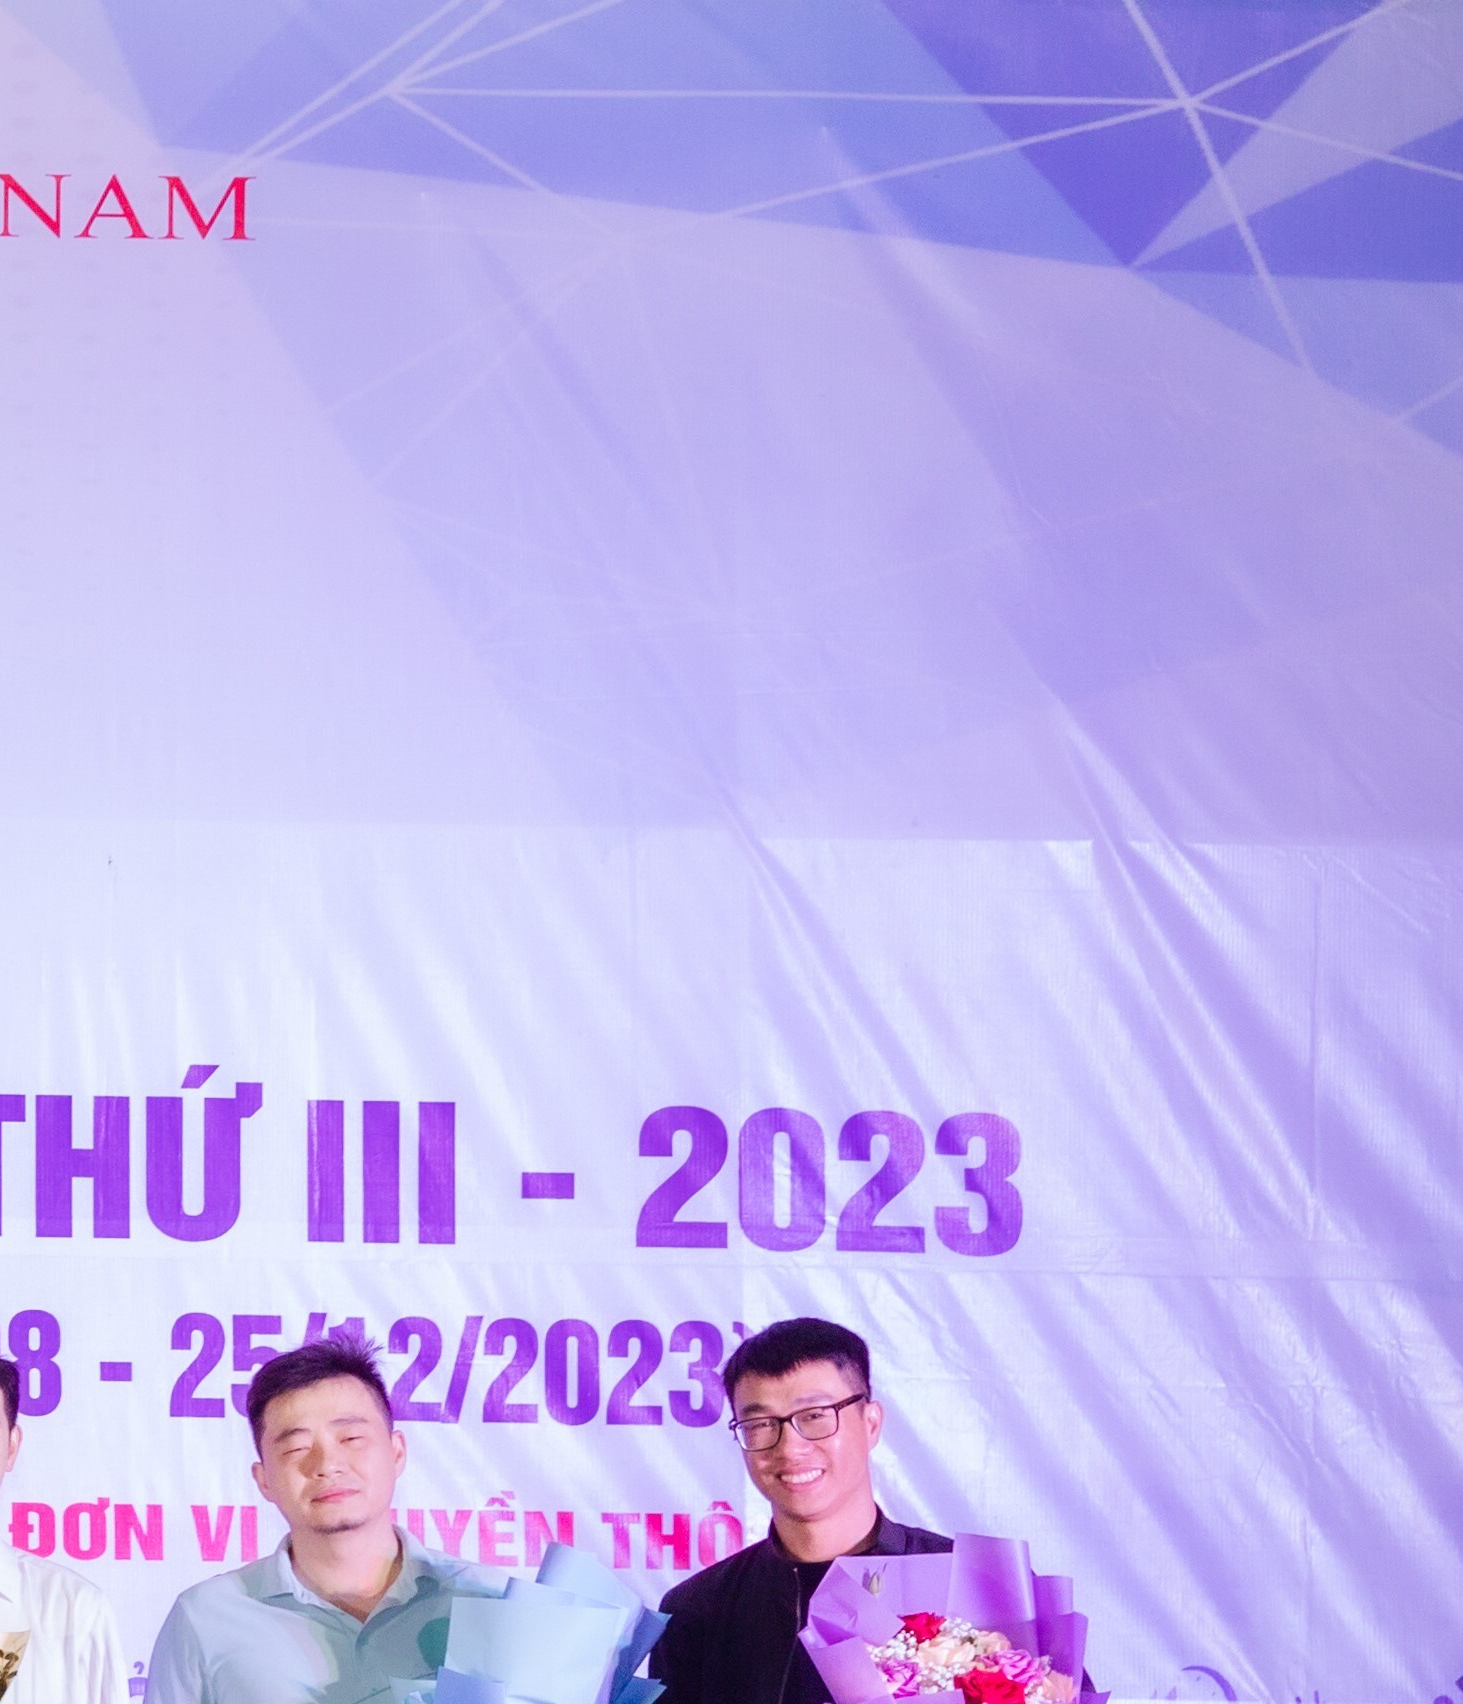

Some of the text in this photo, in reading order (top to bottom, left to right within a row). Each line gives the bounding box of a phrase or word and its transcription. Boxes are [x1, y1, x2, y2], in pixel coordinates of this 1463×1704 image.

[307, 1099, 458, 1247] III
[519, 1171, 576, 1200] -
[635, 1105, 1024, 1258] 2023
[99, 1361, 134, 1382] -
[8, 1497, 165, 1562] ĐƠN
[601, 1500, 745, 1570] THÔ
